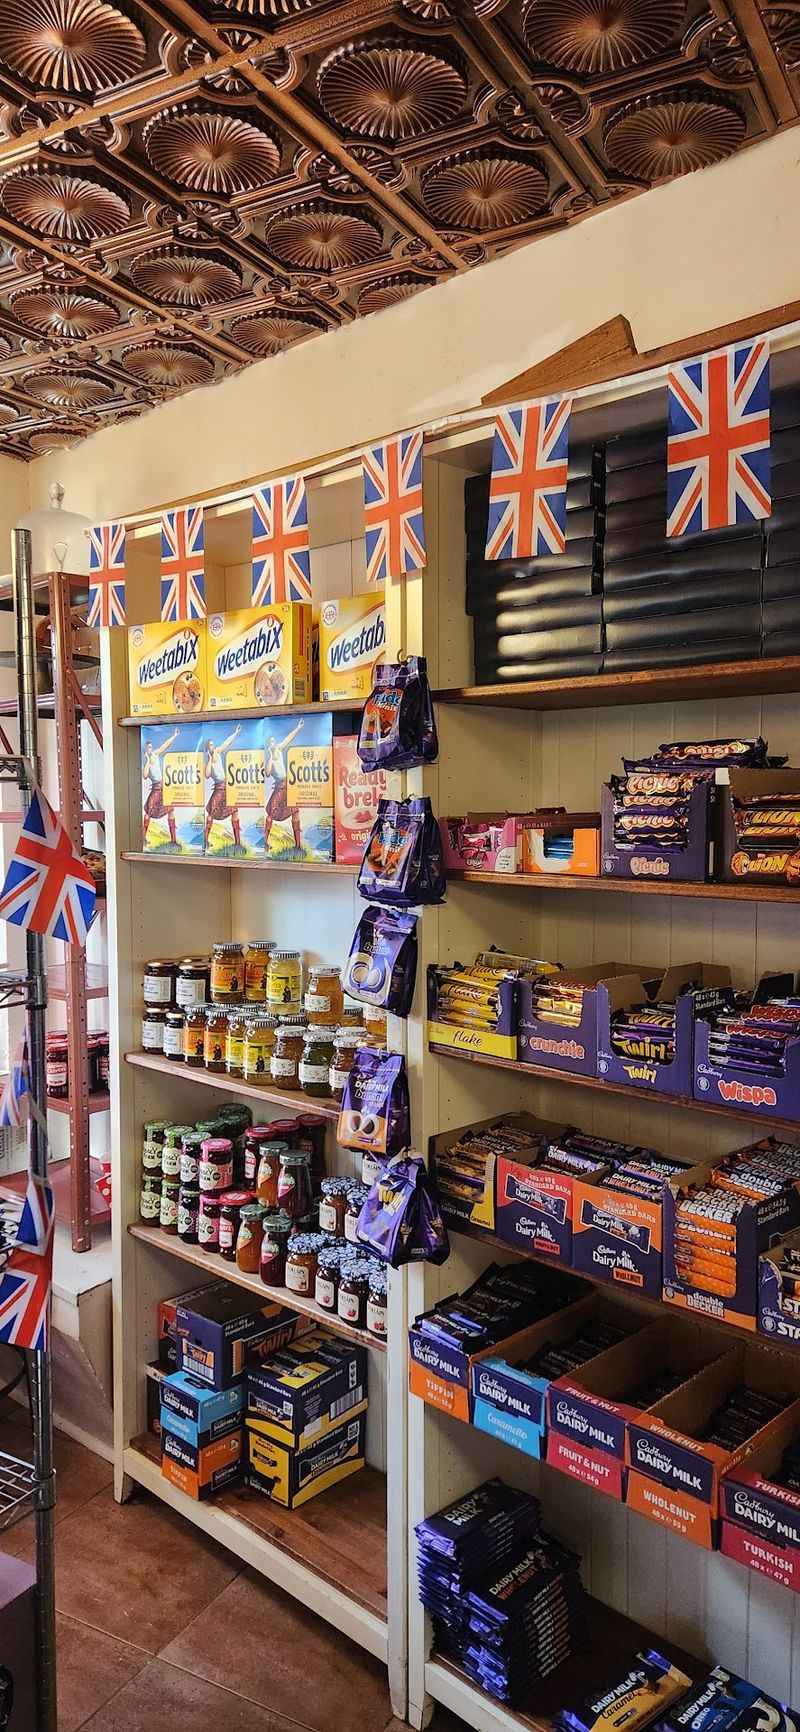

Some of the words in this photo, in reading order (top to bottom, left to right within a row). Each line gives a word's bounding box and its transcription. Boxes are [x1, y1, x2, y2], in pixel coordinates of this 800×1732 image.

[138, 636, 198, 684] Weetabix
[217, 623, 284, 677] Weetabix
[165, 764, 201, 786] Scott's
[228, 762, 265, 786] Scott's
[289, 760, 329, 785] Scott's
[343, 786, 383, 808] brek
[630, 856, 669, 875] Picnic
[612, 1038, 665, 1059] Twirl
[623, 1065, 657, 1083] Twirl
[697, 1064, 723, 1078] Cadbury
[718, 1080, 776, 1106] Wispa
[741, 1172, 782, 1192] double
[592, 1214, 611, 1228] Dairy
[679, 1200, 735, 1223] DECKER
[515, 1222, 536, 1239] Dairy
[536, 1227, 556, 1243] Milk
[592, 1251, 616, 1268] Dairy
[616, 1257, 639, 1272] Milk
[687, 1296, 725, 1318] DECKER
[693, 1292, 724, 1307] double
[413, 1339, 439, 1357] Cadbury
[414, 1349, 439, 1369] DAIRY
[439, 1359, 460, 1378] MILK
[479, 1373, 507, 1394] Cadbury
[479, 1384, 508, 1404] DAIRY
[508, 1396, 531, 1416] MILK
[556, 1401, 588, 1424] Cadbury
[565, 1387, 591, 1403] FRUIT
[598, 1401, 620, 1413] NUT
[557, 1412, 588, 1434] DAIRY
[588, 1426, 615, 1448] MILK
[650, 1424, 704, 1453] WHOLENUT
[559, 1446, 584, 1464] FRUIT
[583, 1457, 591, 1468] &
[591, 1461, 610, 1478] NUT
[636, 1438, 671, 1464] Cadbury
[637, 1450, 672, 1475] DAIRY
[673, 1468, 703, 1490] MILK
[644, 1489, 696, 1523] WHOLENUT
[734, 1491, 776, 1518] Cadbury
[756, 1481, 800, 1507] TURKIS
[443, 1497, 477, 1522] DAIRY
[455, 1507, 483, 1526] MILK
[735, 1503, 776, 1529] DAIRY
[744, 1541, 793, 1573] TURKISH
[489, 1574, 514, 1595] DAIRY
[513, 1558, 532, 1576] MILK
[774, 1572, 783, 1580] 47
[591, 1694, 616, 1714] DAIRY
[615, 1678, 635, 1698] MILK
[601, 1690, 642, 1720] Caramel
[677, 1703, 701, 1724] DAIRY
[699, 1687, 717, 1707] MILK
